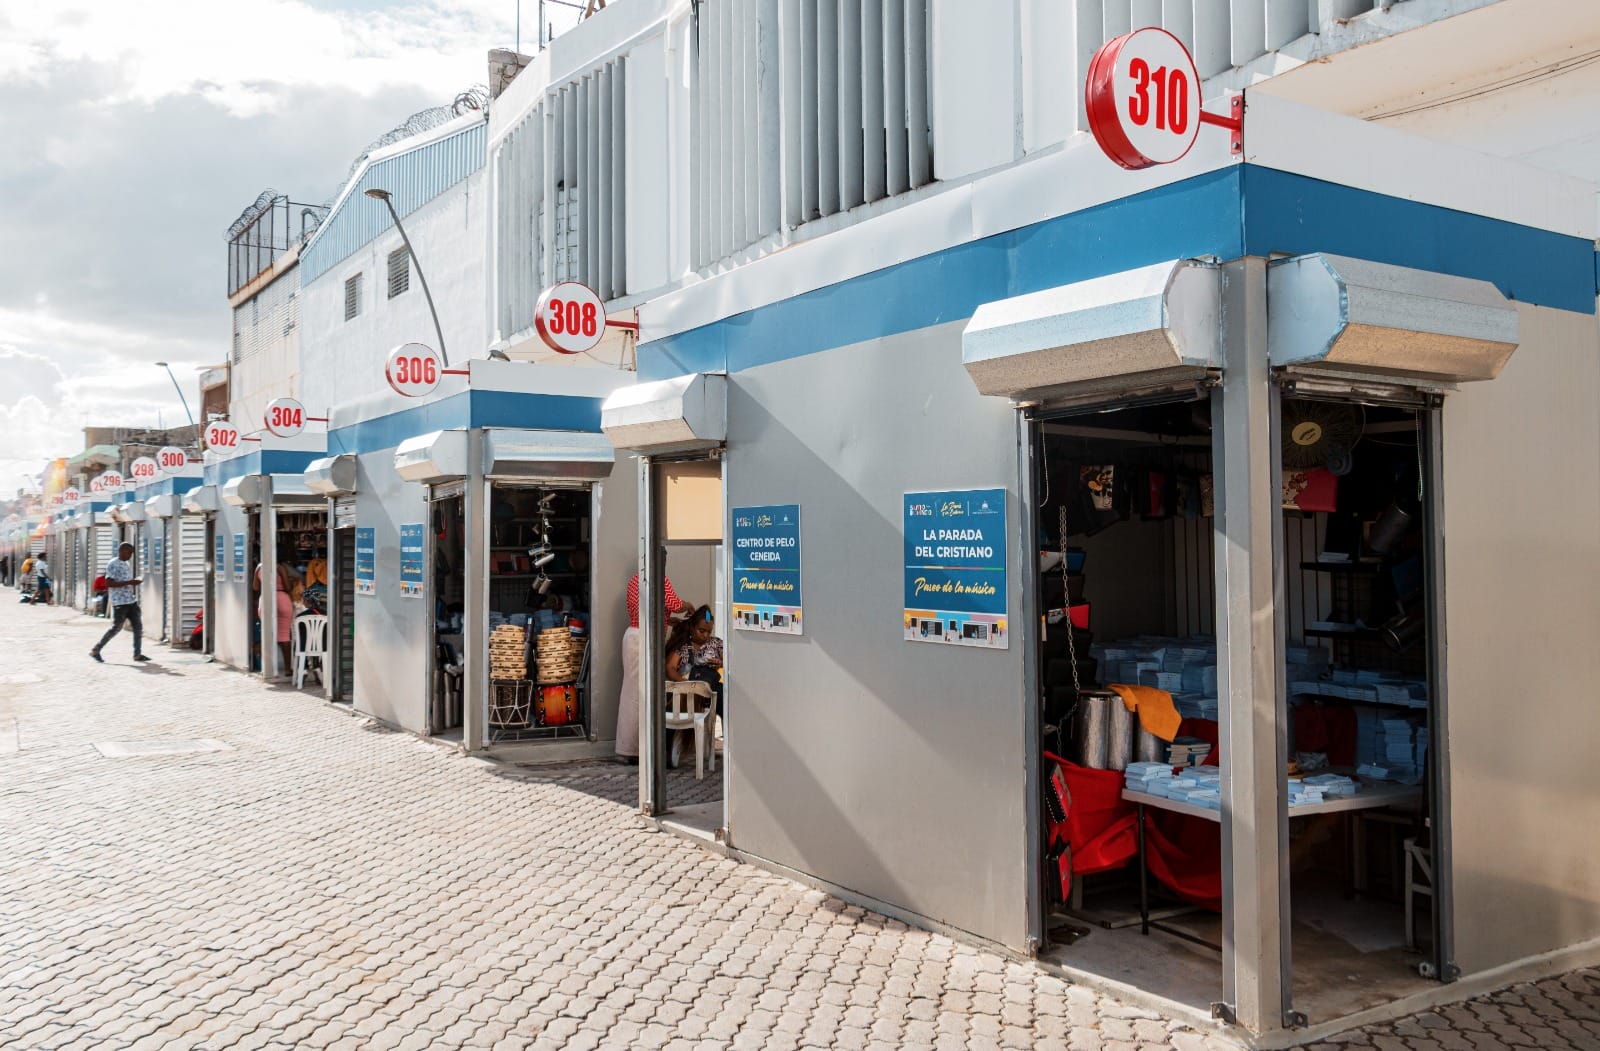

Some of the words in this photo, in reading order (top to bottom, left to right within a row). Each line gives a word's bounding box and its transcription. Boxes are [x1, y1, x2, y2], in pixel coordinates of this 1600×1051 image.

[1129, 57, 1188, 135] 310
[549, 298, 597, 337] 308
[396, 356, 436, 385] 306
[272, 406, 302, 428] 304
[210, 428, 237, 447] 302
[161, 452, 184, 467] 300
[134, 463, 154, 477] 298
[103, 475, 121, 487] 296
[736, 538, 764, 548] CENTRO
[764, 538, 775, 548] DE
[776, 537, 795, 547] PELO
[923, 529, 937, 541] LA
[938, 529, 983, 541] PARADA
[749, 551, 781, 561] CENEIDA
[915, 546, 934, 558] DEL
[936, 546, 993, 558] CRISTIANO
[914, 577, 941, 597] Paseo
[942, 579, 953, 593] de
[954, 580, 964, 594] la
